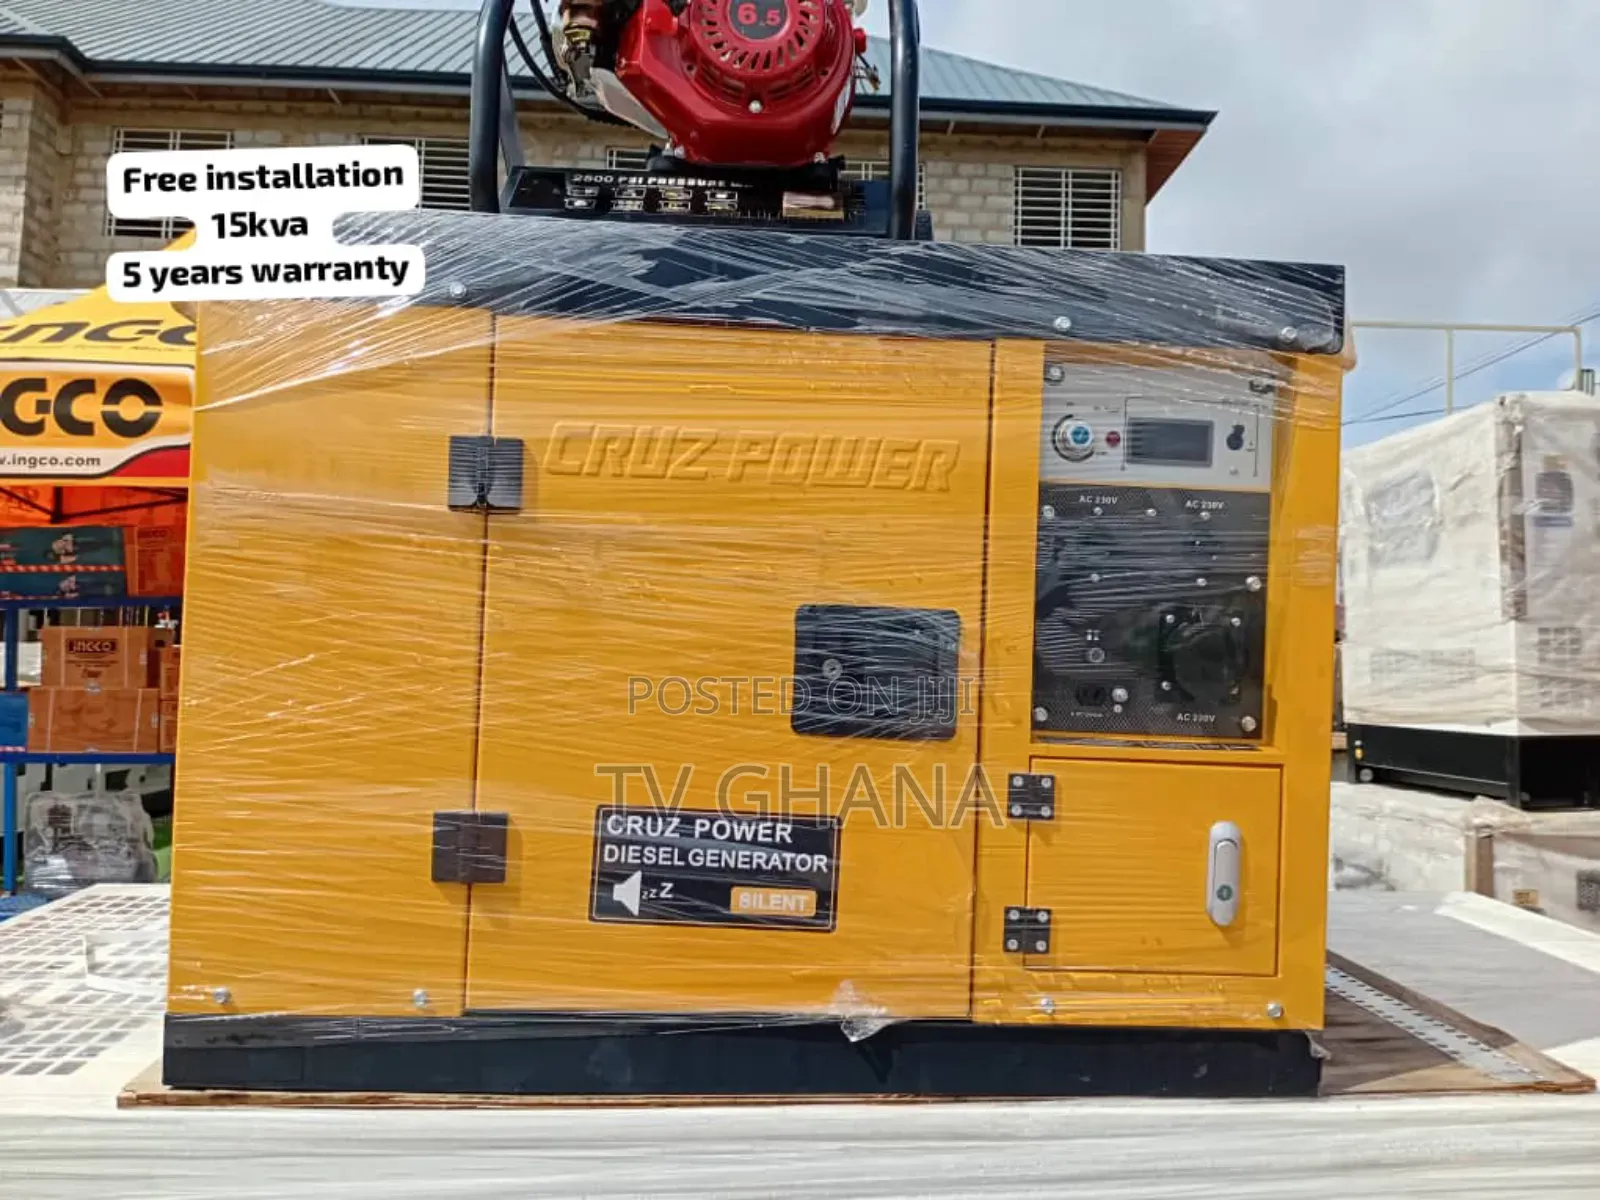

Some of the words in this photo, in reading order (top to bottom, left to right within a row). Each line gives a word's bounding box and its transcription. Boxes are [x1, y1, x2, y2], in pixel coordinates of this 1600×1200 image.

[542, 420, 718, 481] CRUZ
[727, 429, 960, 491] POWER
[1079, 495, 1093, 503] AC
[1185, 500, 1199, 508] AC
[1177, 713, 1190, 721] AC
[606, 814, 681, 838] CRUZ
[694, 818, 793, 843] POWER
[603, 844, 685, 866] DIESEL
[688, 848, 828, 873] GENERATOR
[739, 891, 809, 912] SILENT
